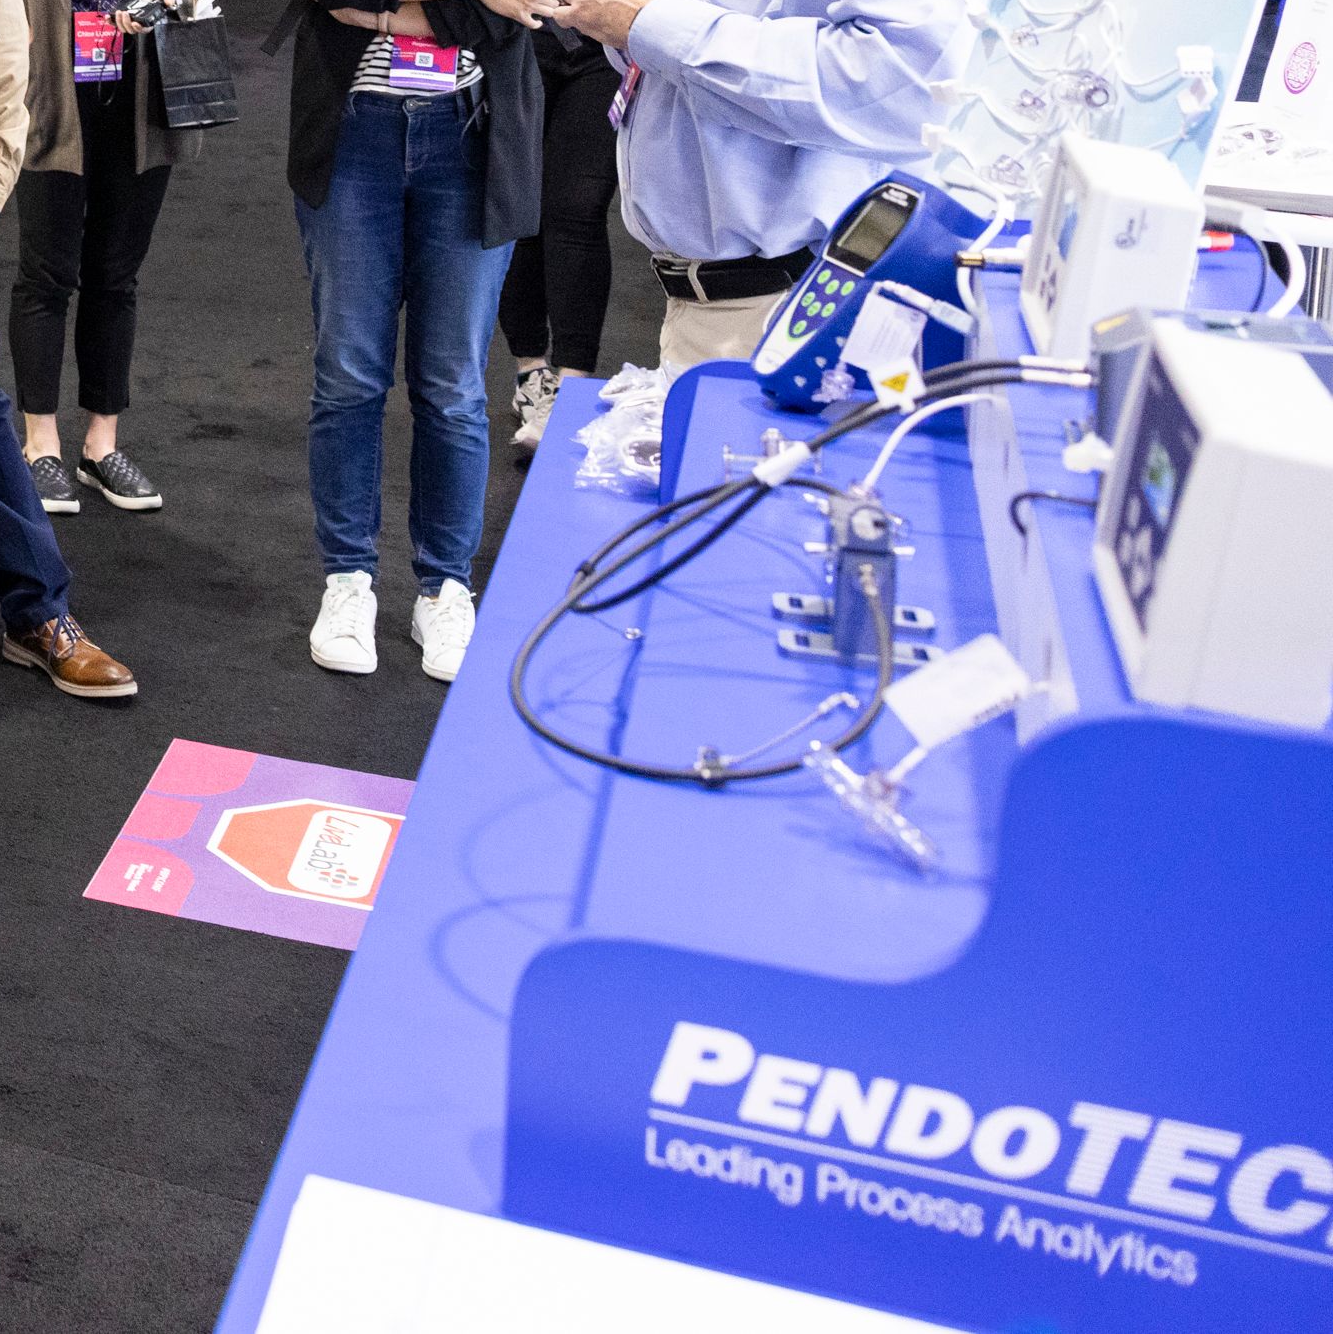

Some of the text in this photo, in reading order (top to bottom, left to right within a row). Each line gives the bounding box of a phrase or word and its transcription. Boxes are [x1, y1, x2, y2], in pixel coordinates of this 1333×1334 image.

[644, 1127, 1199, 1286] Leading Process Analytics
[649, 1020, 1333, 1248] PENDOTEC
